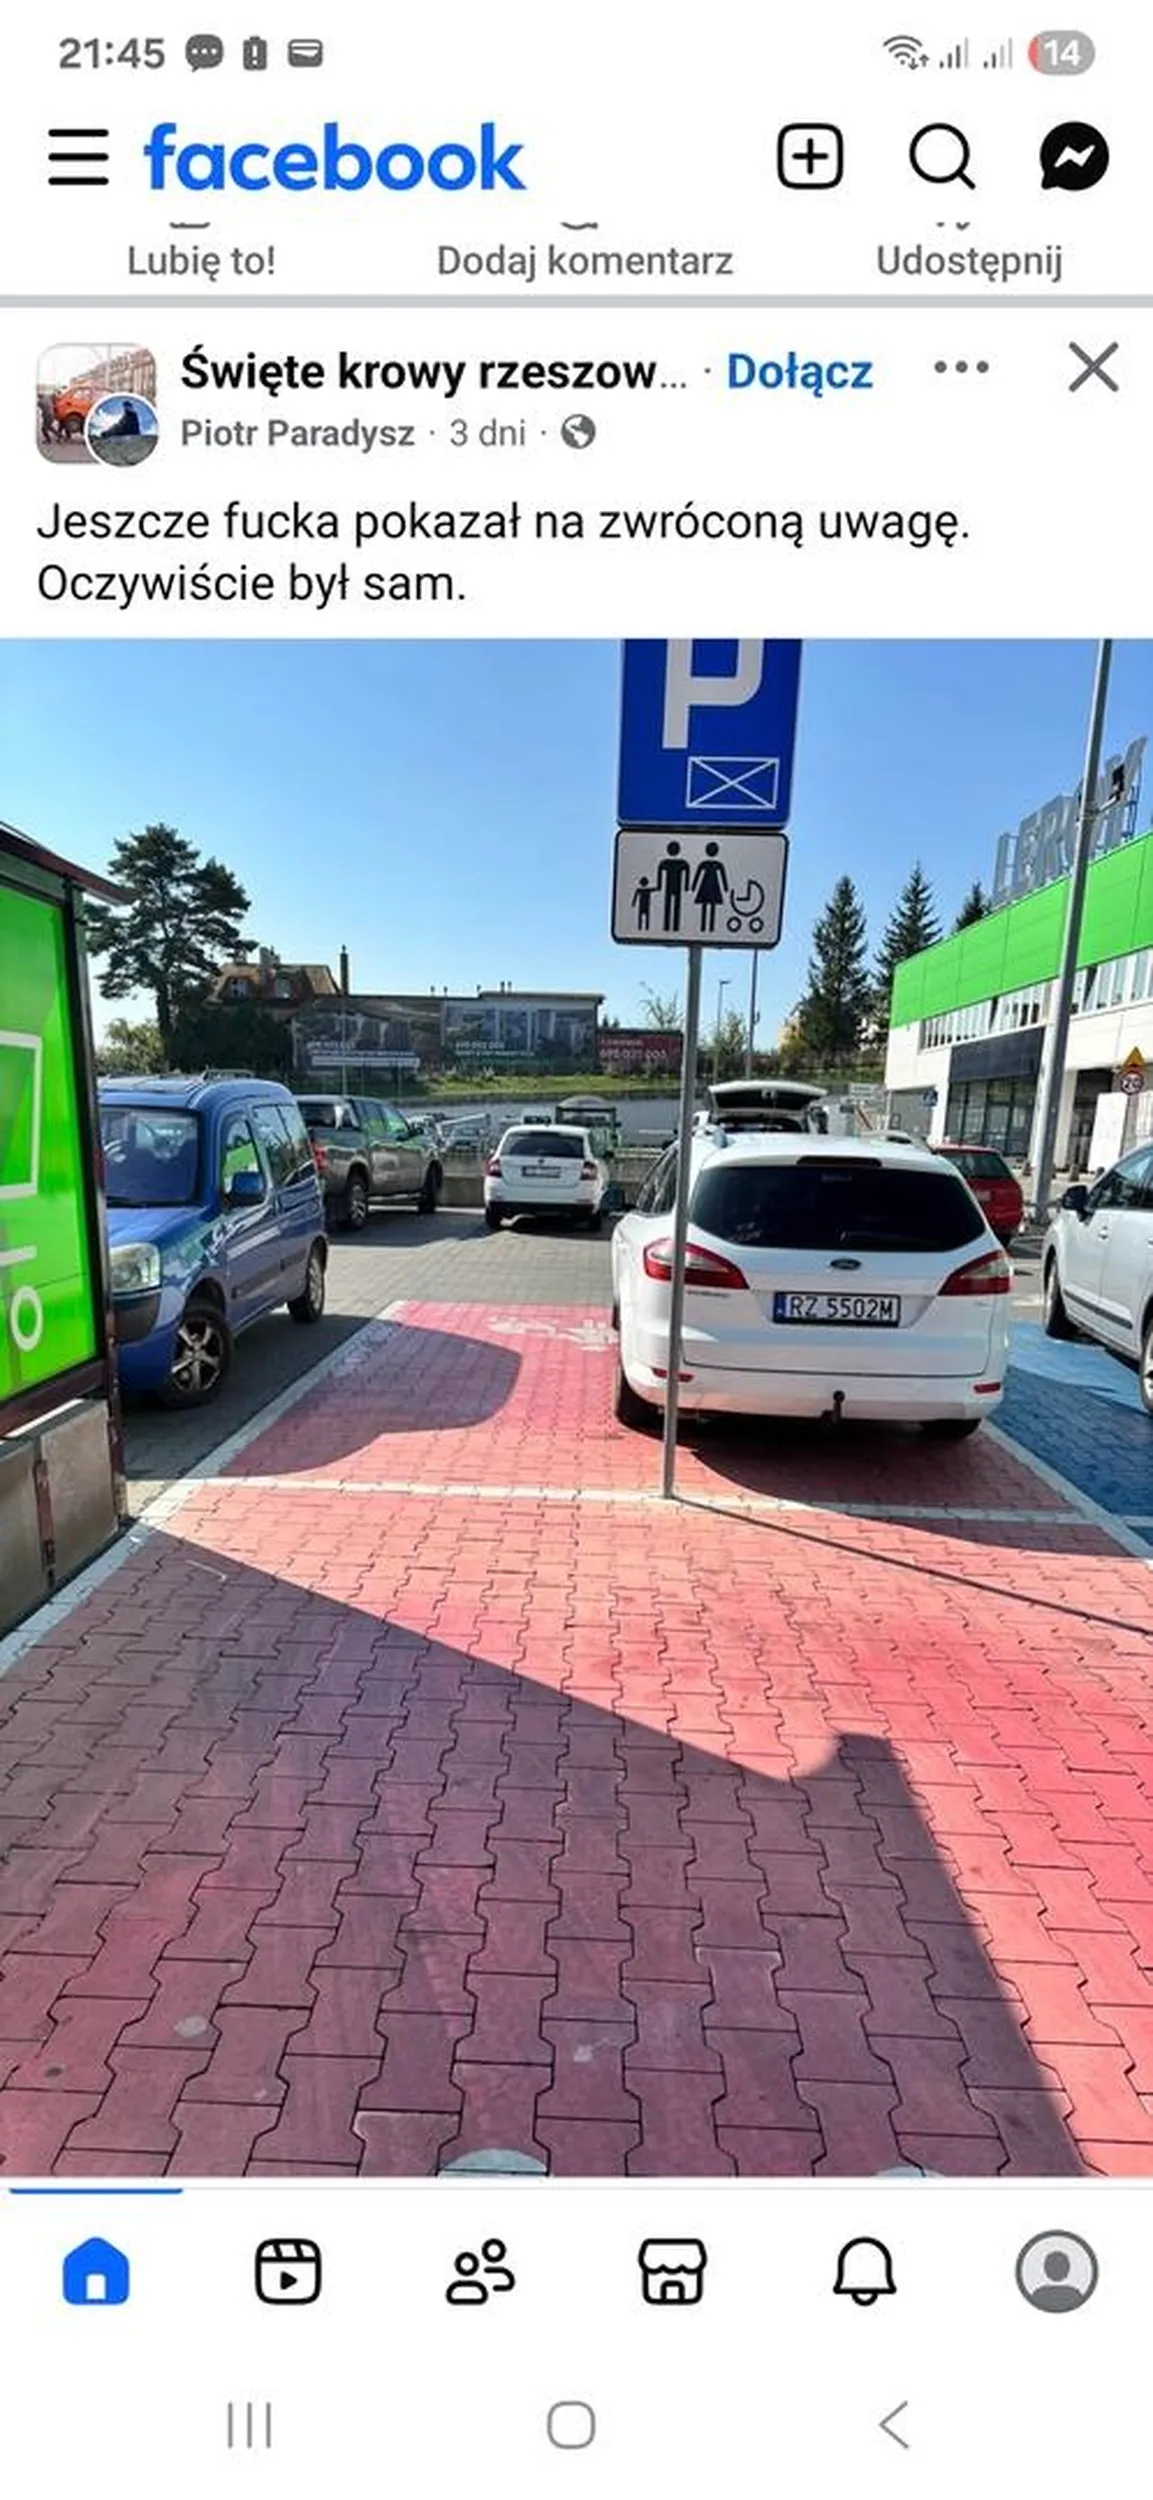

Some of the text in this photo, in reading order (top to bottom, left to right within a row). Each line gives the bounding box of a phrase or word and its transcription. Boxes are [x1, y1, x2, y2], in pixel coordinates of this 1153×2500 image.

[662, 639, 764, 748] P
[790, 1296, 818, 1316] RZ
[826, 1298, 893, 1319] 5502M
